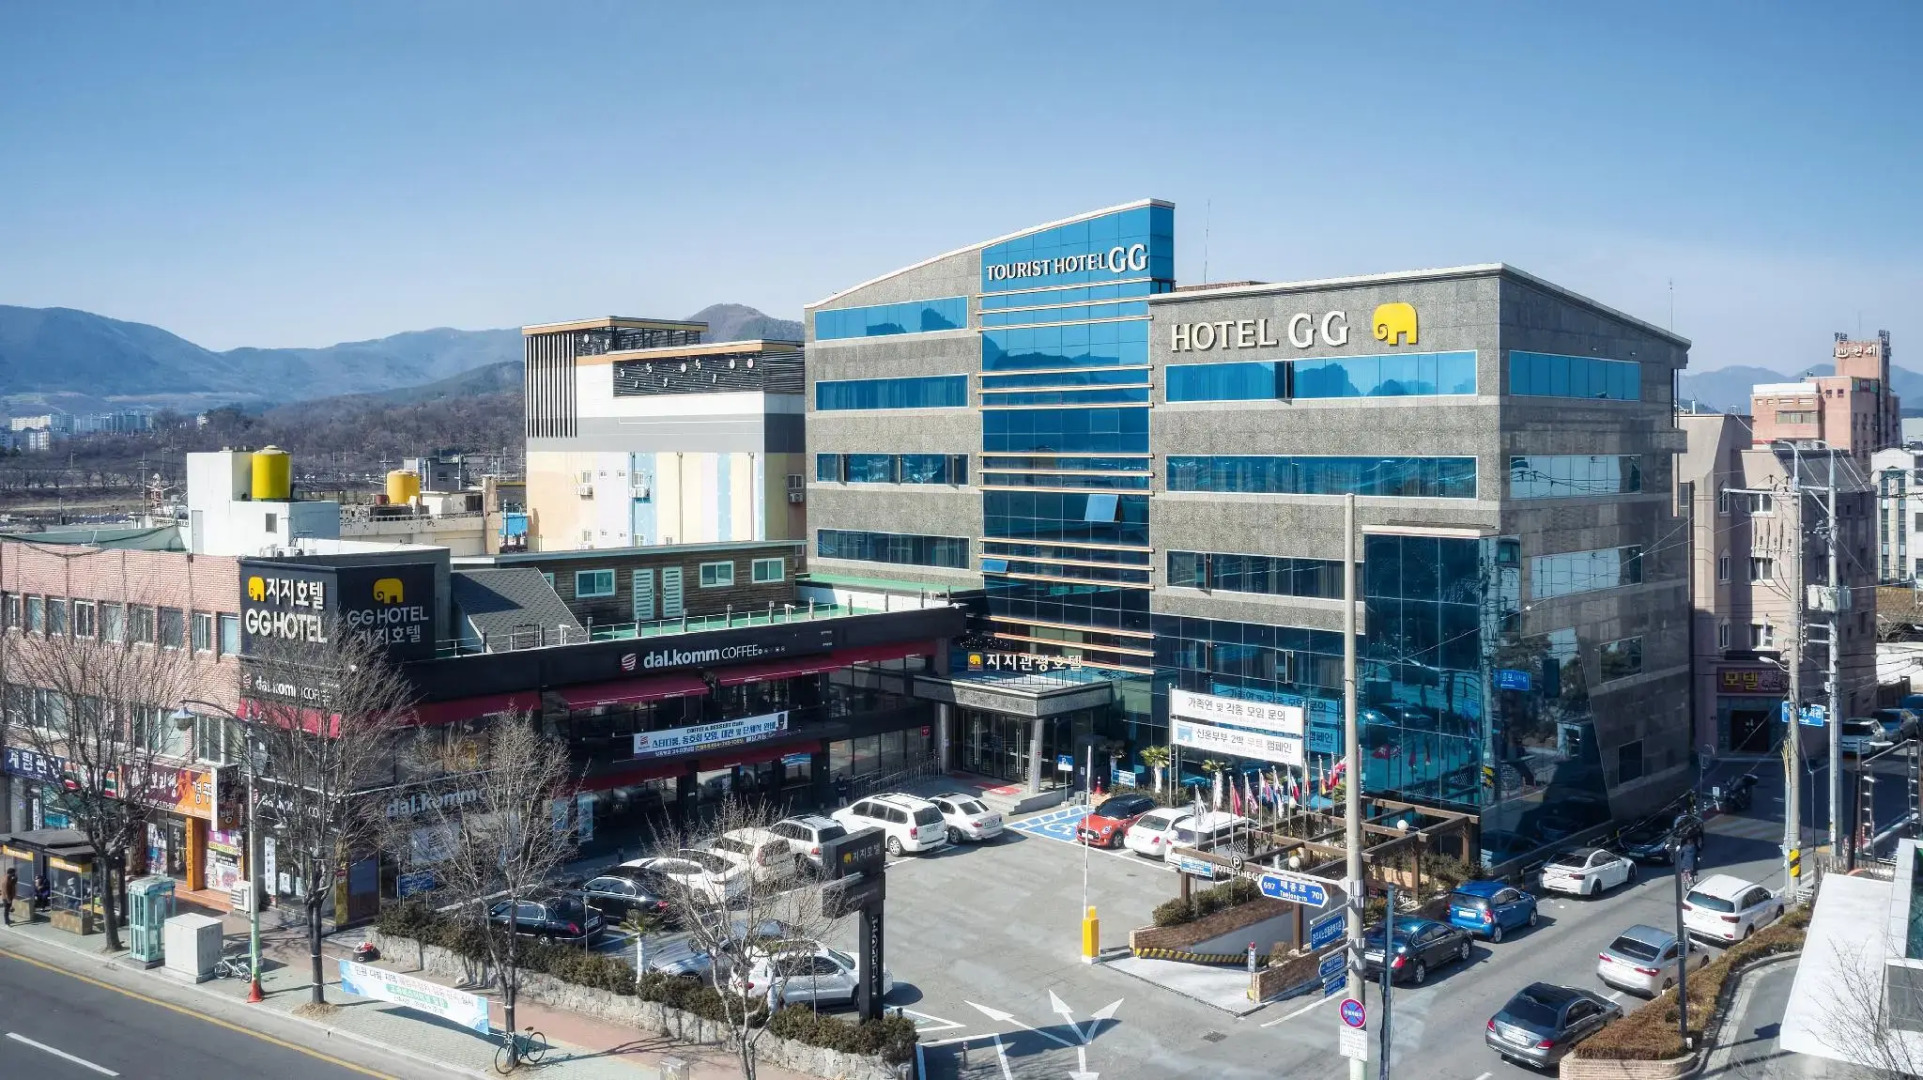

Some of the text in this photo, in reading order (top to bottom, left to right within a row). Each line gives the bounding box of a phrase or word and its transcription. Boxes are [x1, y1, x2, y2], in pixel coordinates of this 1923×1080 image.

[985, 242, 1148, 282] TOURIST HOTEL GG
[1170, 309, 1351, 353] HOTEL GG
[265, 577, 325, 611] 지지호텔
[245, 607, 329, 645] GG HOTEL
[346, 605, 430, 627] GG HOTEL
[356, 624, 423, 646] 지지호텔
[643, 643, 759, 669] dal.komm COFFEE
[986, 653, 1084, 672] 지지관광호텔
[1723, 671, 1759, 690] 모텔
[1188, 696, 1213, 711] 가족연
[1226, 702, 1244, 716] 각종
[1247, 706, 1265, 719] 모임
[1267, 709, 1286, 722] 문의
[1196, 727, 1228, 743] 신혼부부
[1266, 740, 1292, 755] 캠페인
[1263, 881, 1276, 890] 697
[1280, 880, 1307, 893] 태종로
[1311, 890, 1323, 900] 701
